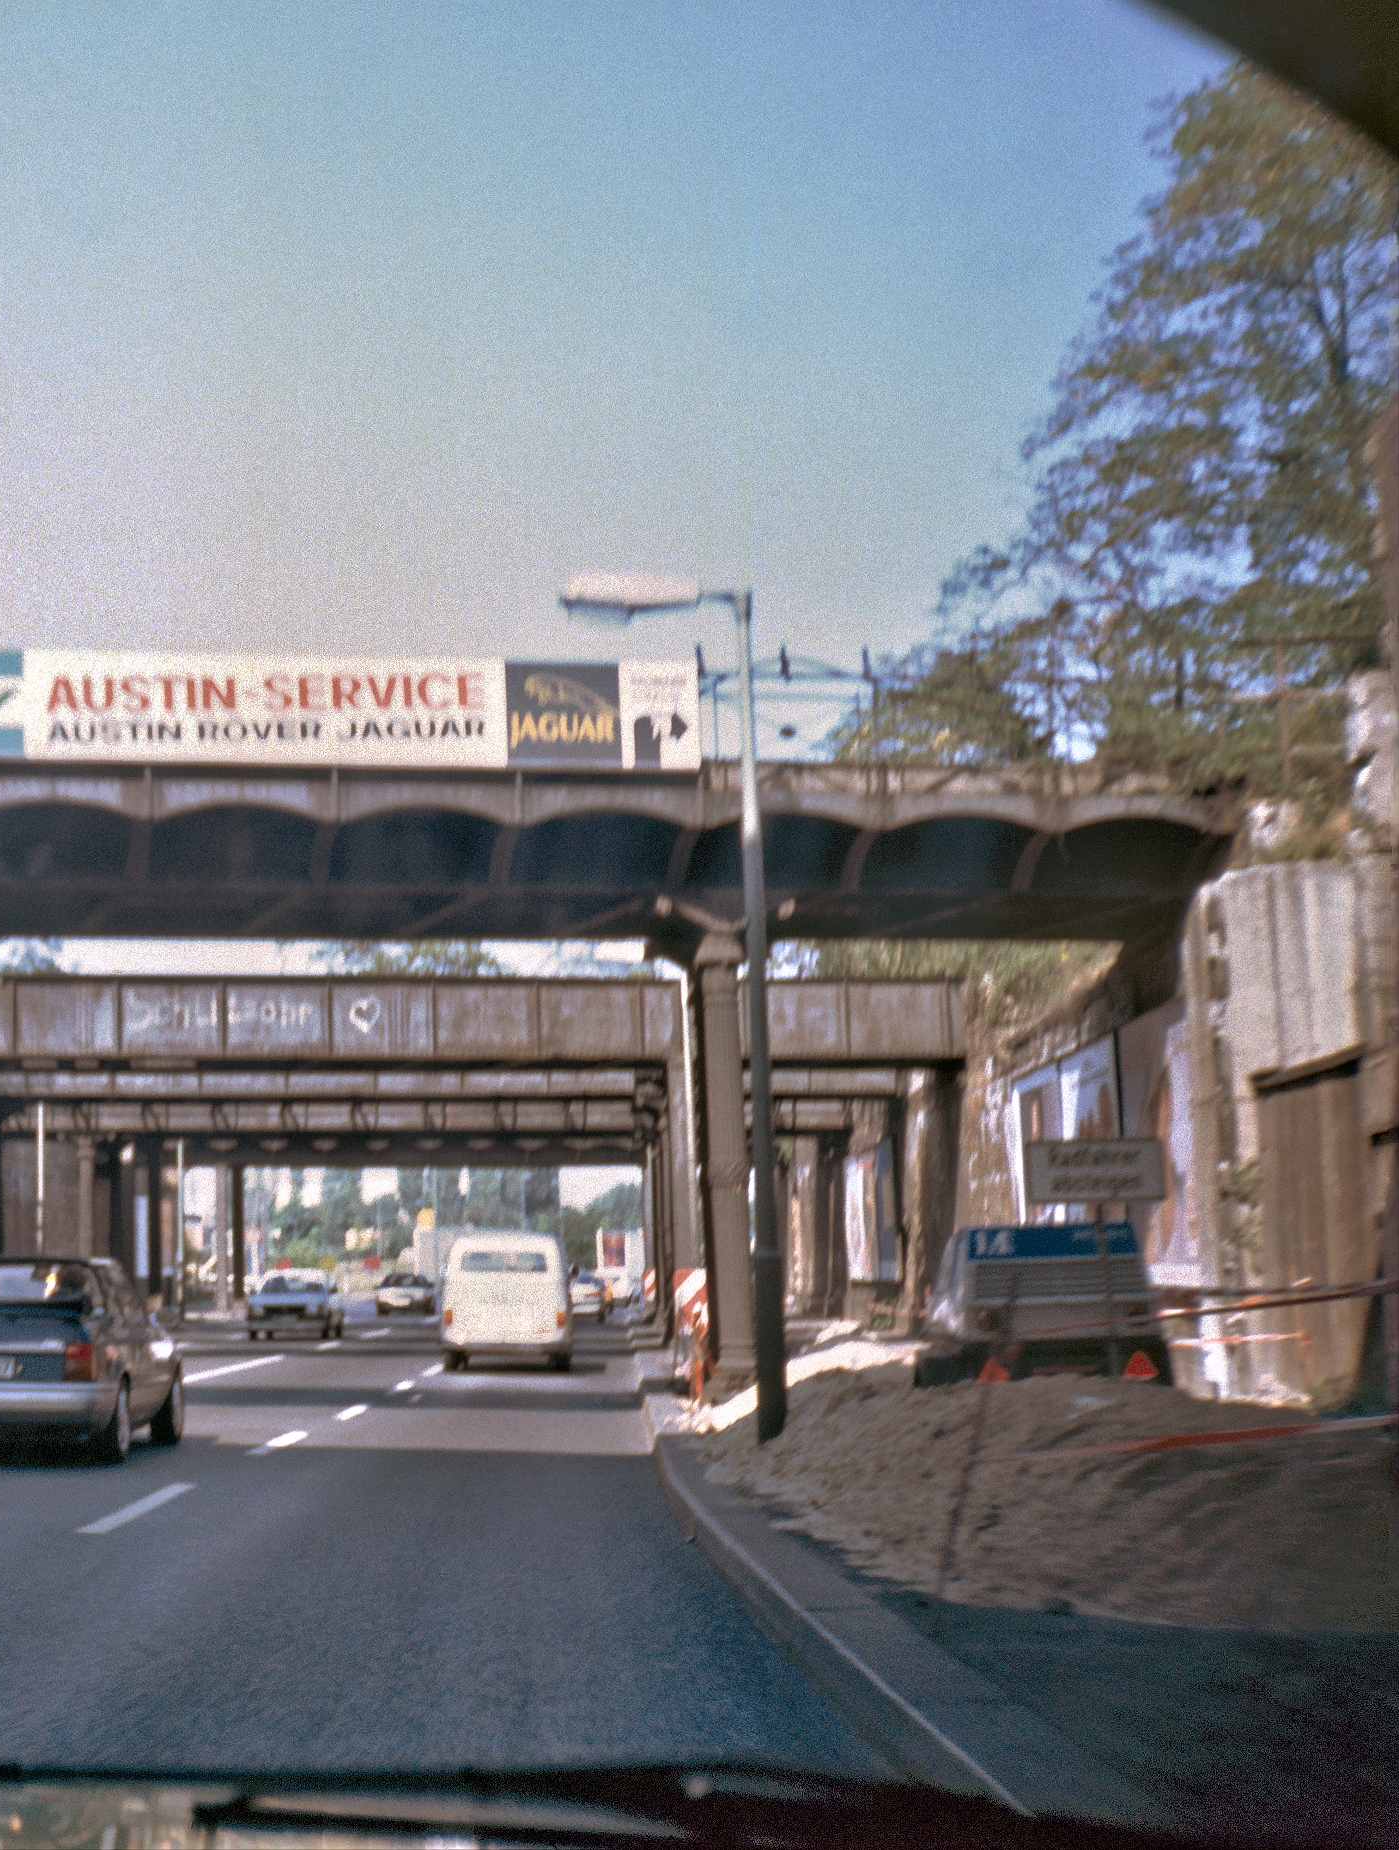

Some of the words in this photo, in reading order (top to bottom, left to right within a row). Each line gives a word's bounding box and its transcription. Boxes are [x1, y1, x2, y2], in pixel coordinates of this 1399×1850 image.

[48, 721, 182, 742] AUSTIN
[198, 719, 322, 742] ROVER
[337, 718, 486, 741] JAGUAR
[510, 711, 616, 749] JAGUAR
